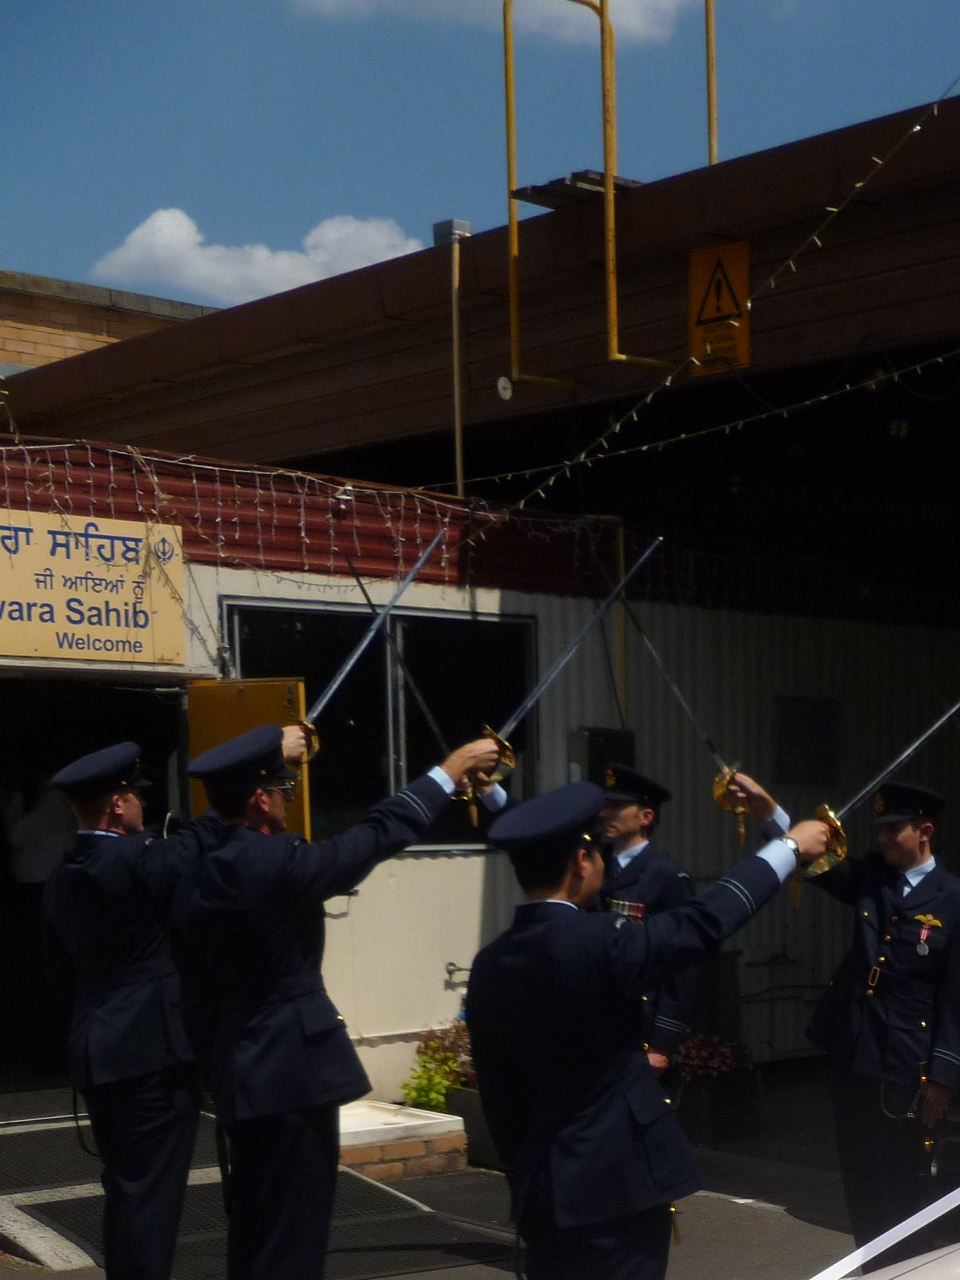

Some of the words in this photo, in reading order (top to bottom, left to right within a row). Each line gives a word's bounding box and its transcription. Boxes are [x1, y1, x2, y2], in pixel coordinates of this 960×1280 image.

[47, 522, 143, 566] ਸਾਹਿਬ
[34, 568, 55, 591] ਜੀ
[65, 597, 150, 630] Sahib
[55, 631, 144, 654] Welcome
